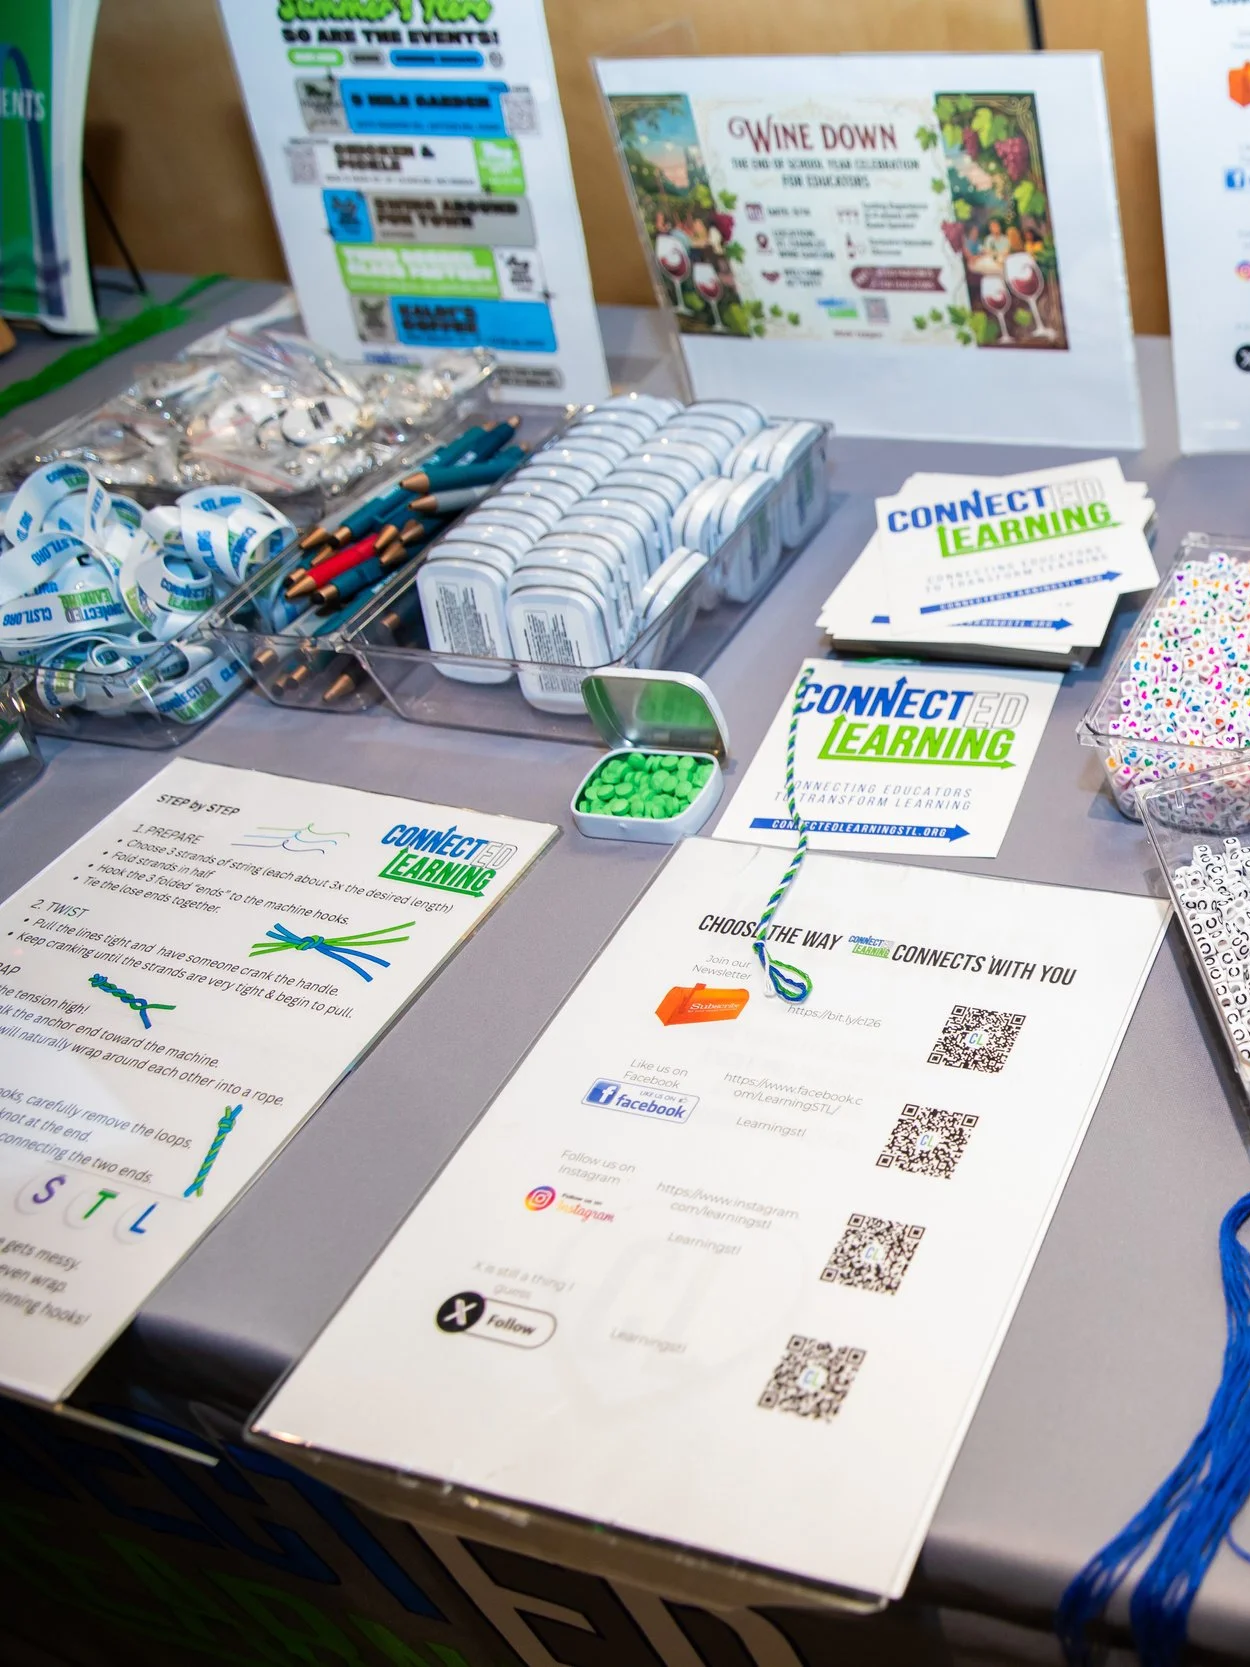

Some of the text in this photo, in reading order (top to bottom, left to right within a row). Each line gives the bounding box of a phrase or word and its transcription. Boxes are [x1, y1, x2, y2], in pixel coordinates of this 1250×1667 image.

[318, 29, 356, 44] ARE
[361, 30, 401, 44] THE
[821, 122, 898, 151] DOWN
[887, 478, 1106, 534] CONNECTED
[937, 501, 1120, 558] LEARNING
[799, 677, 1029, 729] CONNECTED
[818, 713, 1015, 770] LEARNING
[799, 792, 971, 811] TRANSFORM LEARNING
[883, 784, 973, 798] EDUCATORS
[157, 793, 240, 816] STEP STEP
[145, 825, 204, 844] PREPARE
[381, 825, 518, 869] CONNECTED
[112, 851, 177, 873] Fold strands
[378, 846, 497, 898] LEARNING
[127, 839, 454, 914] Choose strands string about the desired length)
[97, 863, 350, 926] Hook folded the machine hooks.
[119, 886, 221, 914] lose ends together.
[47, 901, 89, 919] TWIST
[33, 918, 339, 998] Pull the lines tight and have someone crank the handle.
[706, 954, 751, 969] Join our
[767, 924, 803, 944] THE
[802, 930, 843, 951] WAY
[892, 944, 986, 973] CONNECTS
[987, 957, 1036, 981] WITH
[1039, 964, 1077, 986] YOU
[17, 931, 354, 1020] Keep cranking until the strands are very tight begin pull.
[692, 964, 752, 981] Newsletter
[15, 990, 90, 1015] tension high!
[12, 1008, 219, 1069] the anchor end toward the machine.
[18, 1029, 284, 1106] naturally wrap around each other into rope.
[623, 1070, 680, 1089] Facebook
[630, 1059, 688, 1077] Like us on
[26, 1095, 155, 1137] carefully remove the
[615, 1094, 686, 1118] facebook
[40, 1119, 65, 1134] the
[68, 1150, 119, 1173] the two
[561, 1149, 598, 1166] Follow
[32, 1174, 158, 1234] S T L
[486, 1313, 536, 1337] Follow
